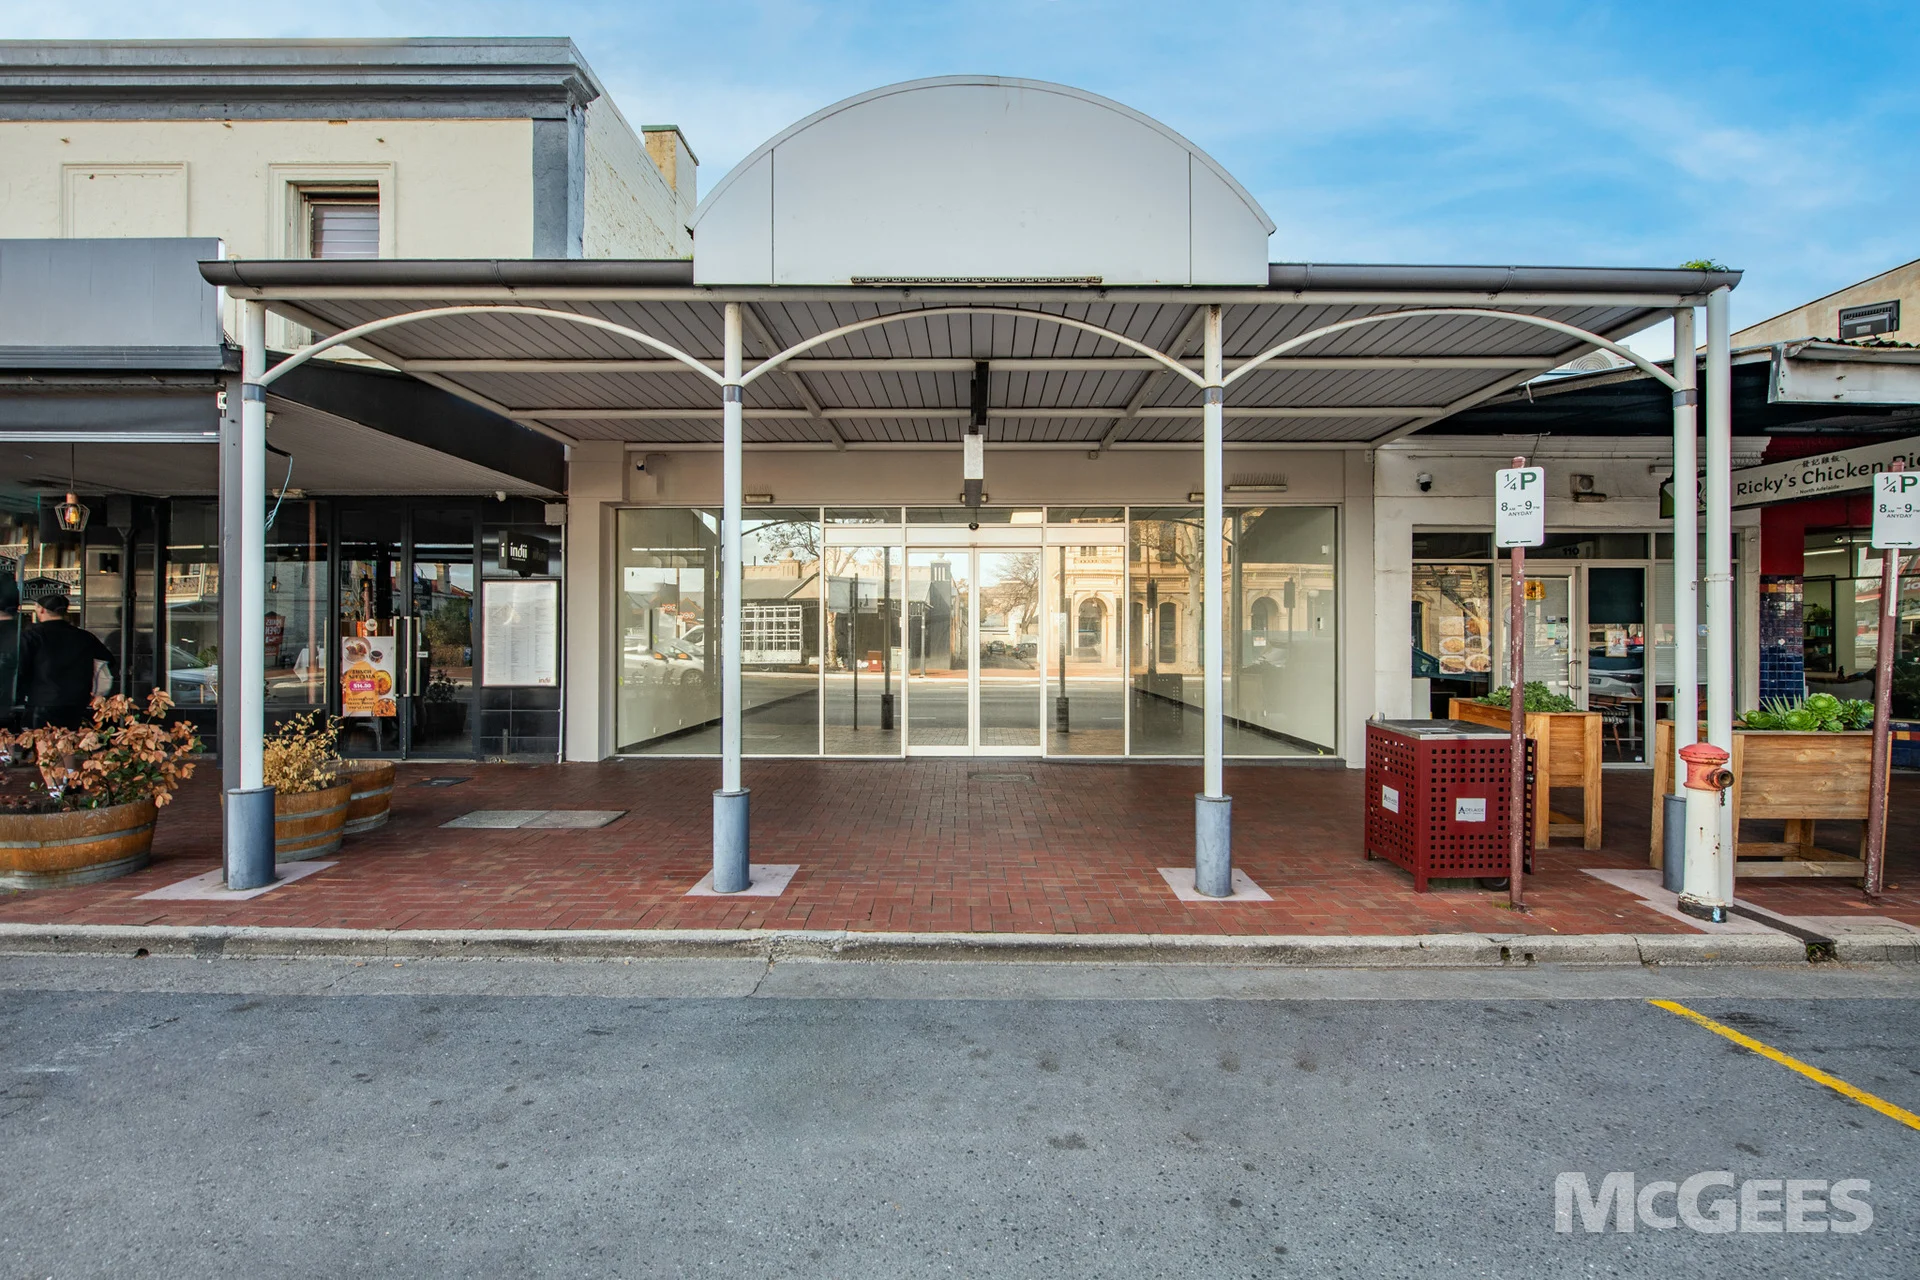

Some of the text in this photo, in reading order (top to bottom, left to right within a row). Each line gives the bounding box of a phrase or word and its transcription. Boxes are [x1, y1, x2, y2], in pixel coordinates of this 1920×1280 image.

[1737, 474, 1796, 495] Ricky's
[1802, 462, 1883, 484] Chicken
[510, 542, 527, 558] indii
[1563, 547, 1579, 555] 110
